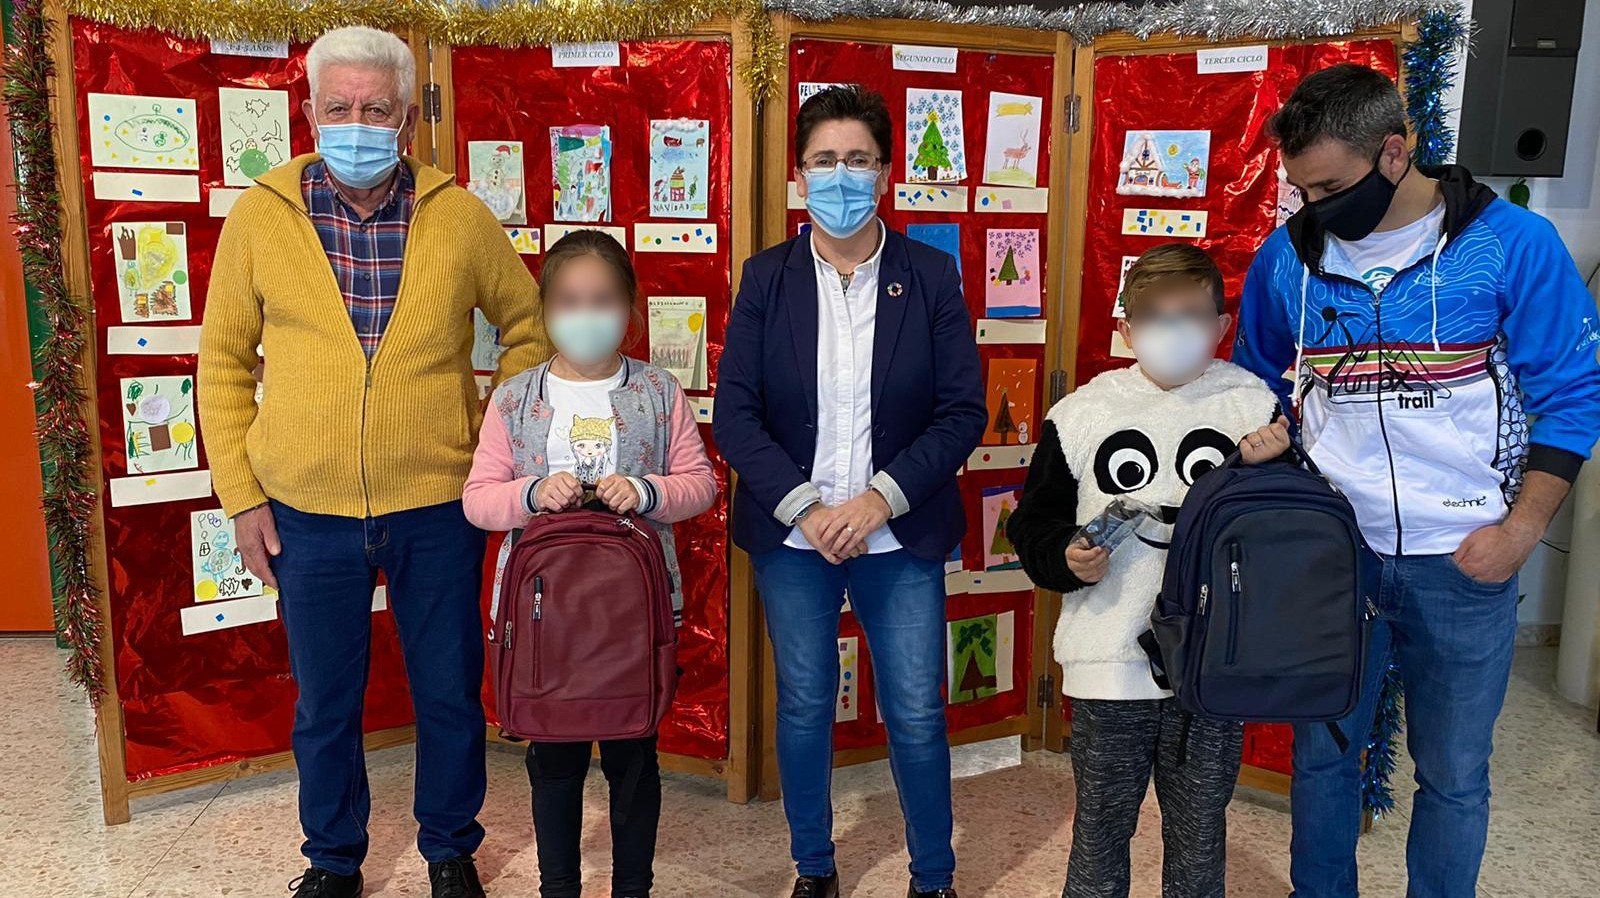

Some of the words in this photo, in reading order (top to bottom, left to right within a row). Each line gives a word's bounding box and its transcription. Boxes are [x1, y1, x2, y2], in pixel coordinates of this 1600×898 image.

[558, 50, 588, 59] PRIMER
[589, 50, 614, 59] CICLO
[895, 52, 932, 63] SEGUNDO
[932, 56, 955, 65] CICLO
[1204, 56, 1236, 65] TERCER
[1237, 54, 1263, 63] CICLO
[653, 203, 690, 212] NAVIDAD
[1398, 390, 1434, 409] trail
